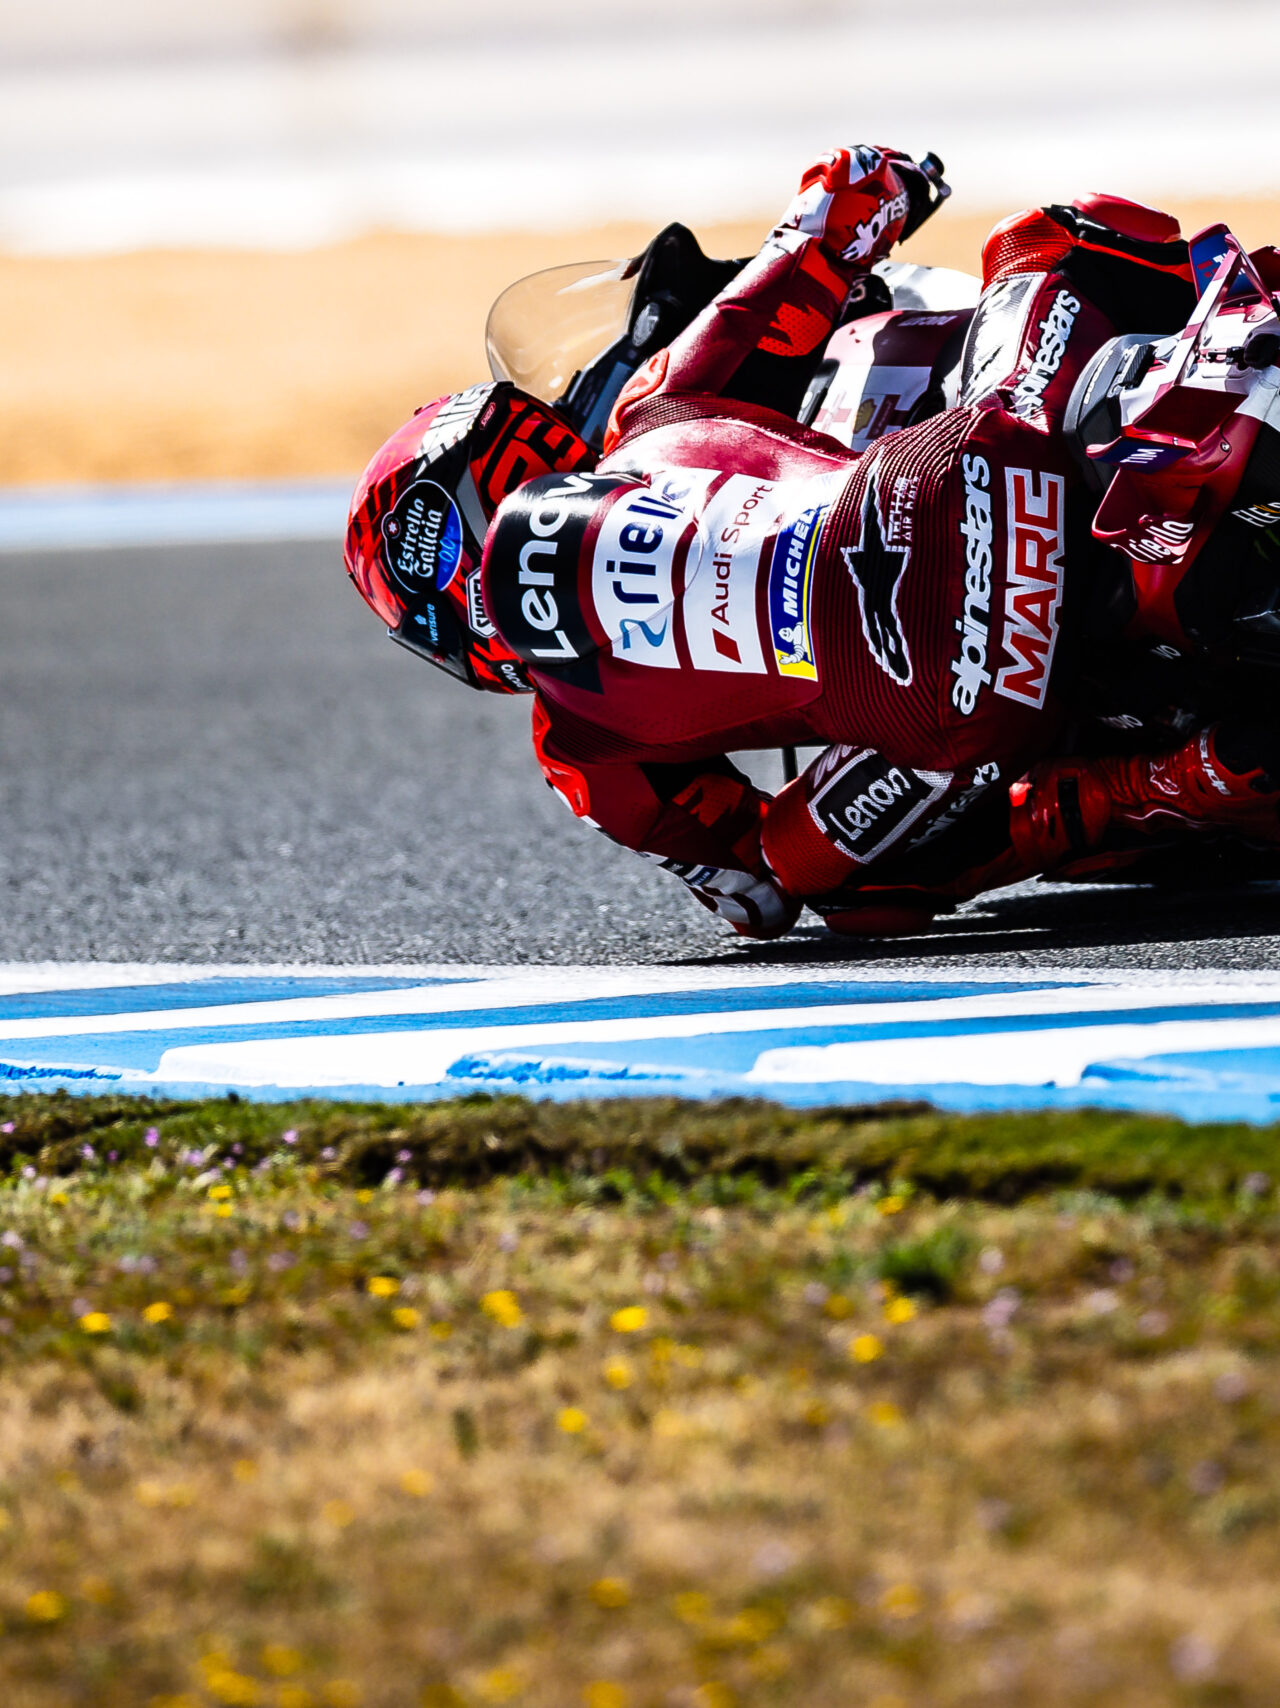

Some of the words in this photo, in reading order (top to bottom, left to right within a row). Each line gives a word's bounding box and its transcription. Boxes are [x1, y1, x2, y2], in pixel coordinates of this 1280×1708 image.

[1119, 448, 1165, 464] TIM
[397, 498, 425, 576] Estrella
[413, 508, 443, 578] Galicia
[720, 485, 774, 544] Sport
[1128, 520, 1194, 562] riello
[518, 472, 604, 659] Lenov
[711, 552, 733, 626] Audi
[782, 506, 818, 618] MICHEL
[951, 453, 993, 716] alpinestars
[994, 467, 1065, 710] MARC
